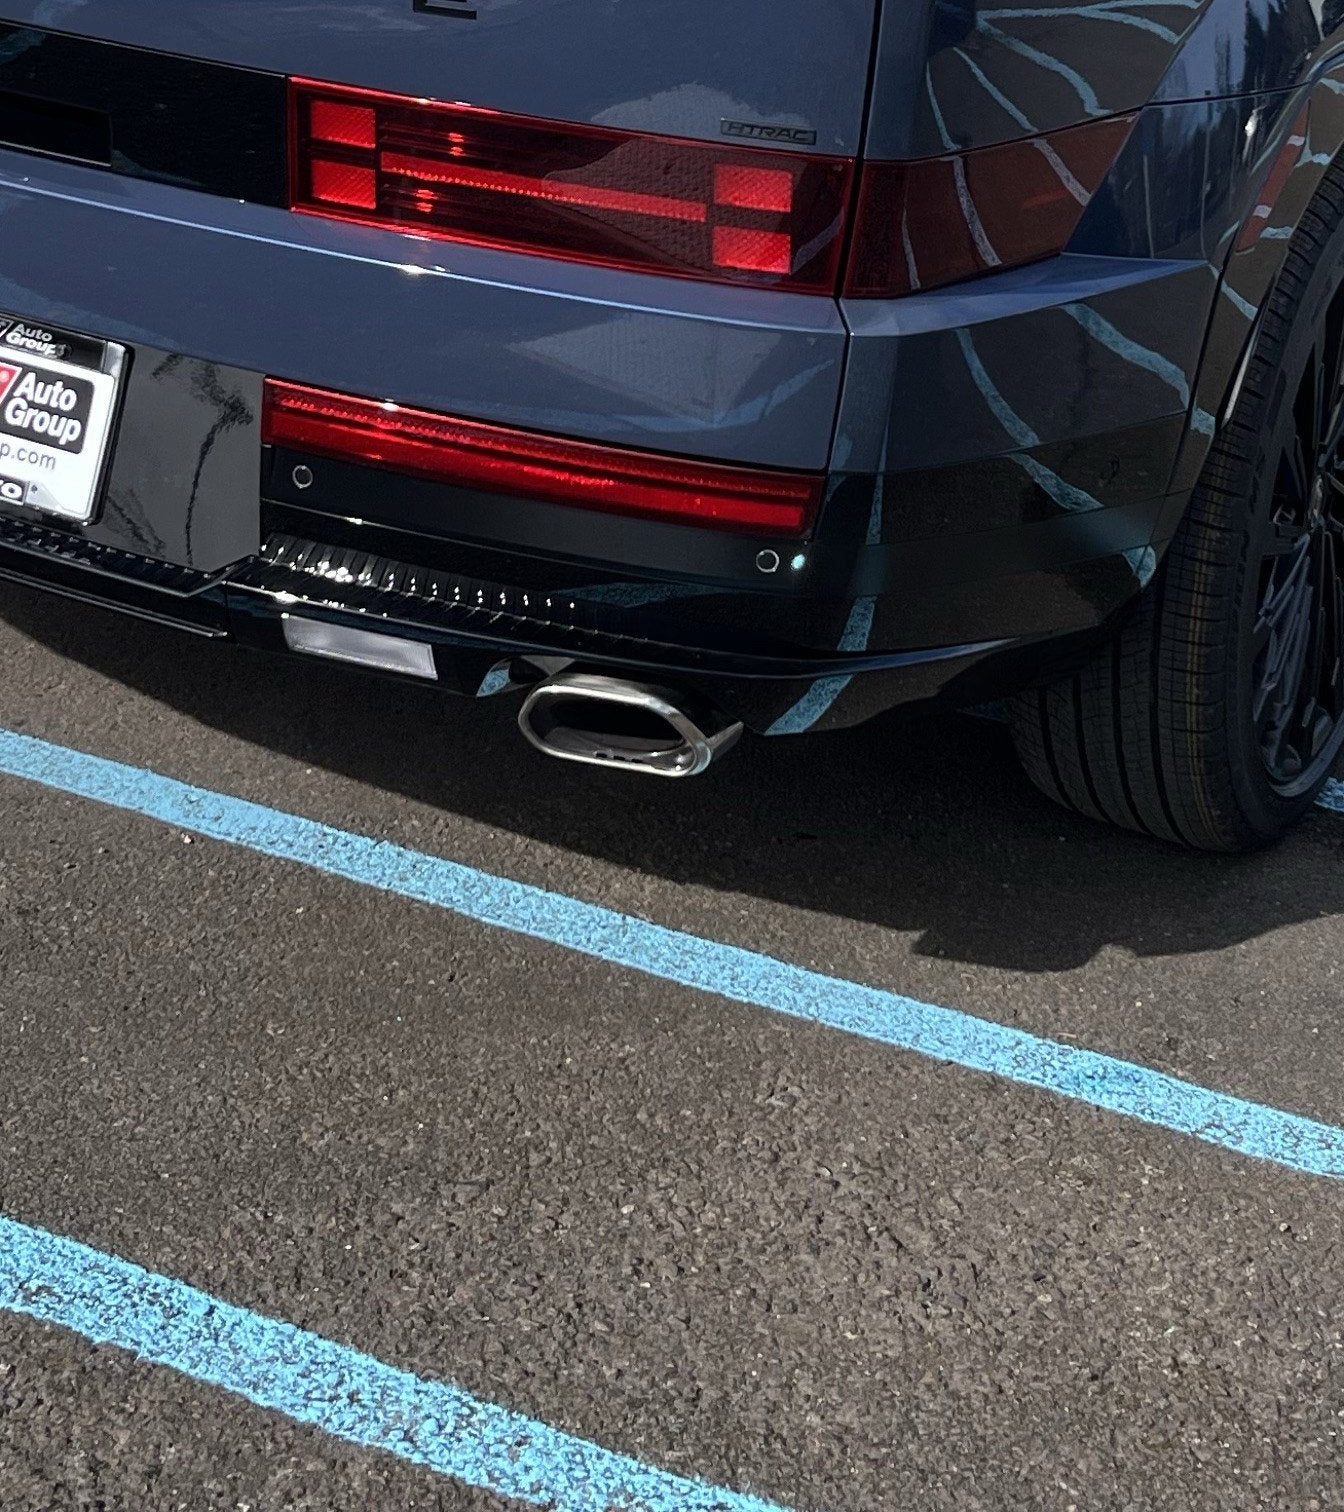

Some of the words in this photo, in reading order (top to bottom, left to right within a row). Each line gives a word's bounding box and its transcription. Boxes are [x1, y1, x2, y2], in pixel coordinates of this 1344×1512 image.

[6, 334, 56, 356] Group
[13, 322, 53, 342] Auto
[12, 372, 78, 413] Auto
[5, 396, 82, 445] Group
